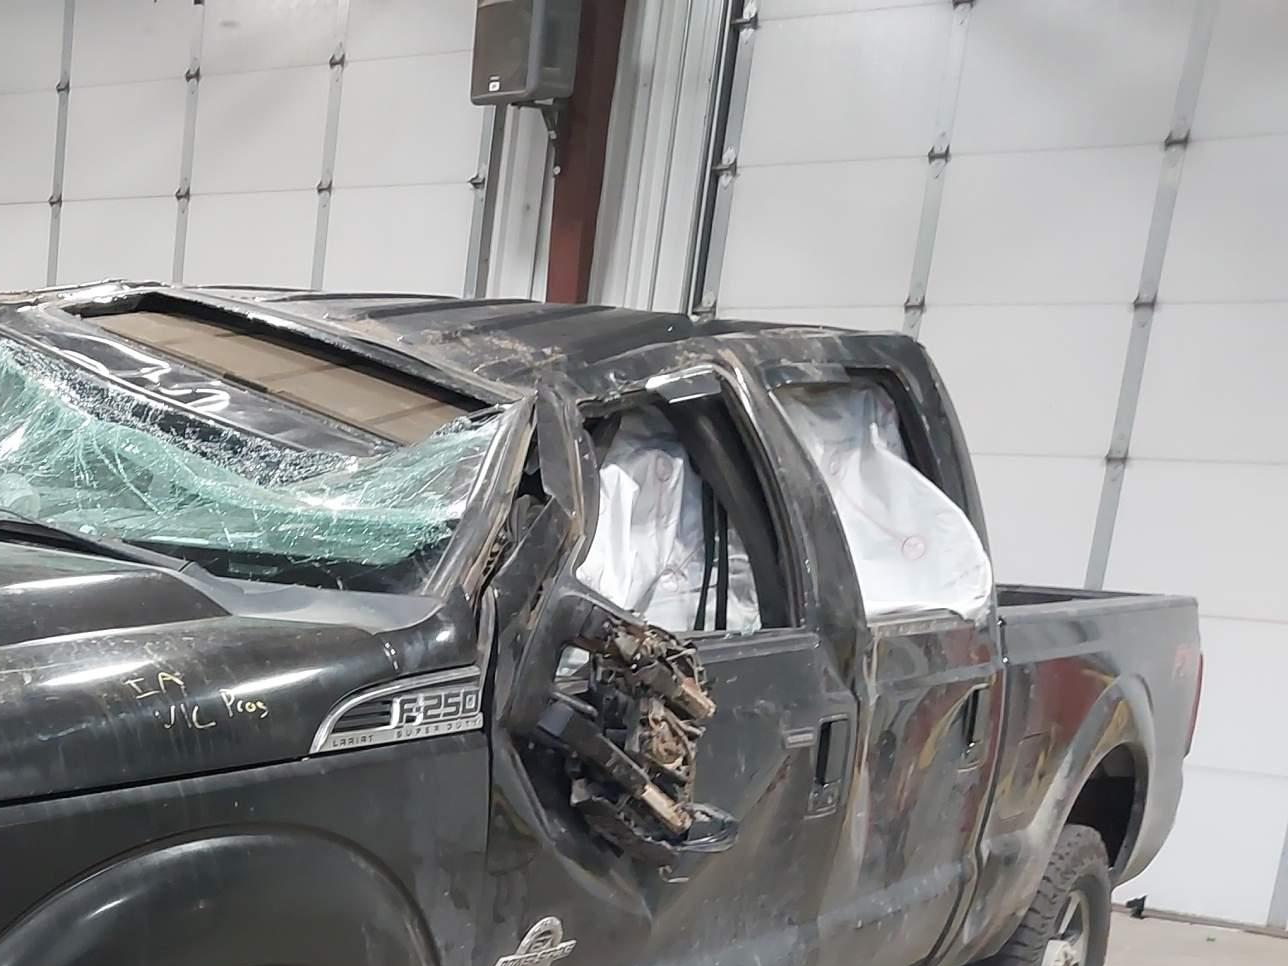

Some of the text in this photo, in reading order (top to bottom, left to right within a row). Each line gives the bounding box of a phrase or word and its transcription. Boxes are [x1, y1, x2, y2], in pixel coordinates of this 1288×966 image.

[396, 688, 481, 726] F-250
[332, 734, 374, 747] LARIAT
[396, 726, 439, 739] SUPER
